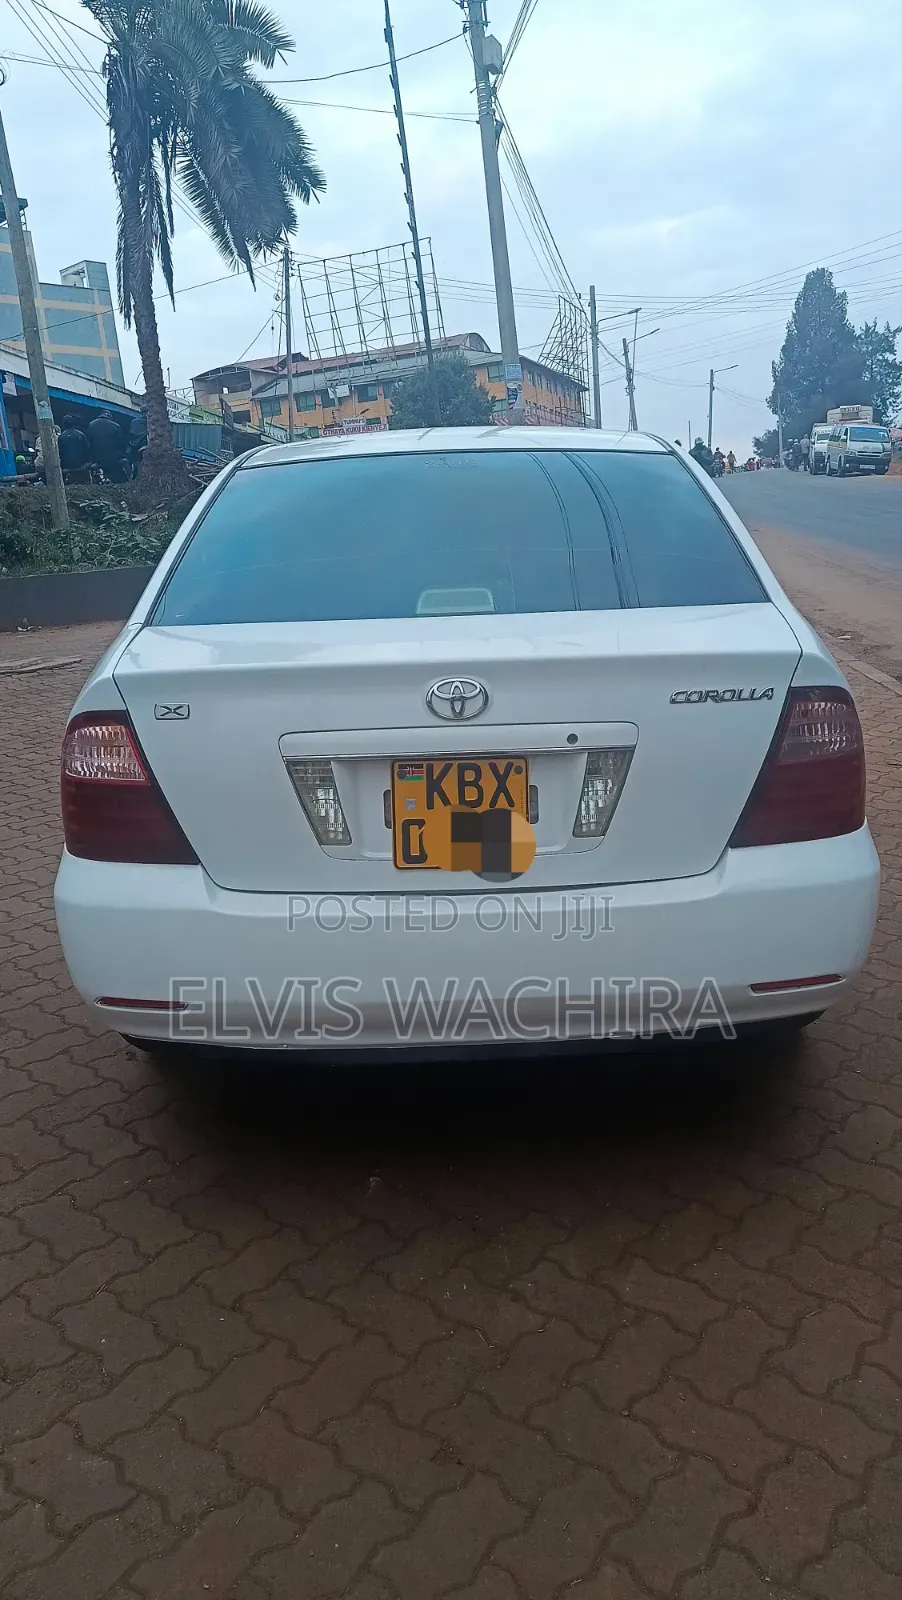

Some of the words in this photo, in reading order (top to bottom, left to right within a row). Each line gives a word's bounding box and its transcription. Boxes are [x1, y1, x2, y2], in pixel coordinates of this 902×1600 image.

[323, 427, 345, 436] OTHAYA
[669, 687, 774, 704] COROLLA
[158, 704, 186, 718] X
[425, 761, 515, 810] KBX
